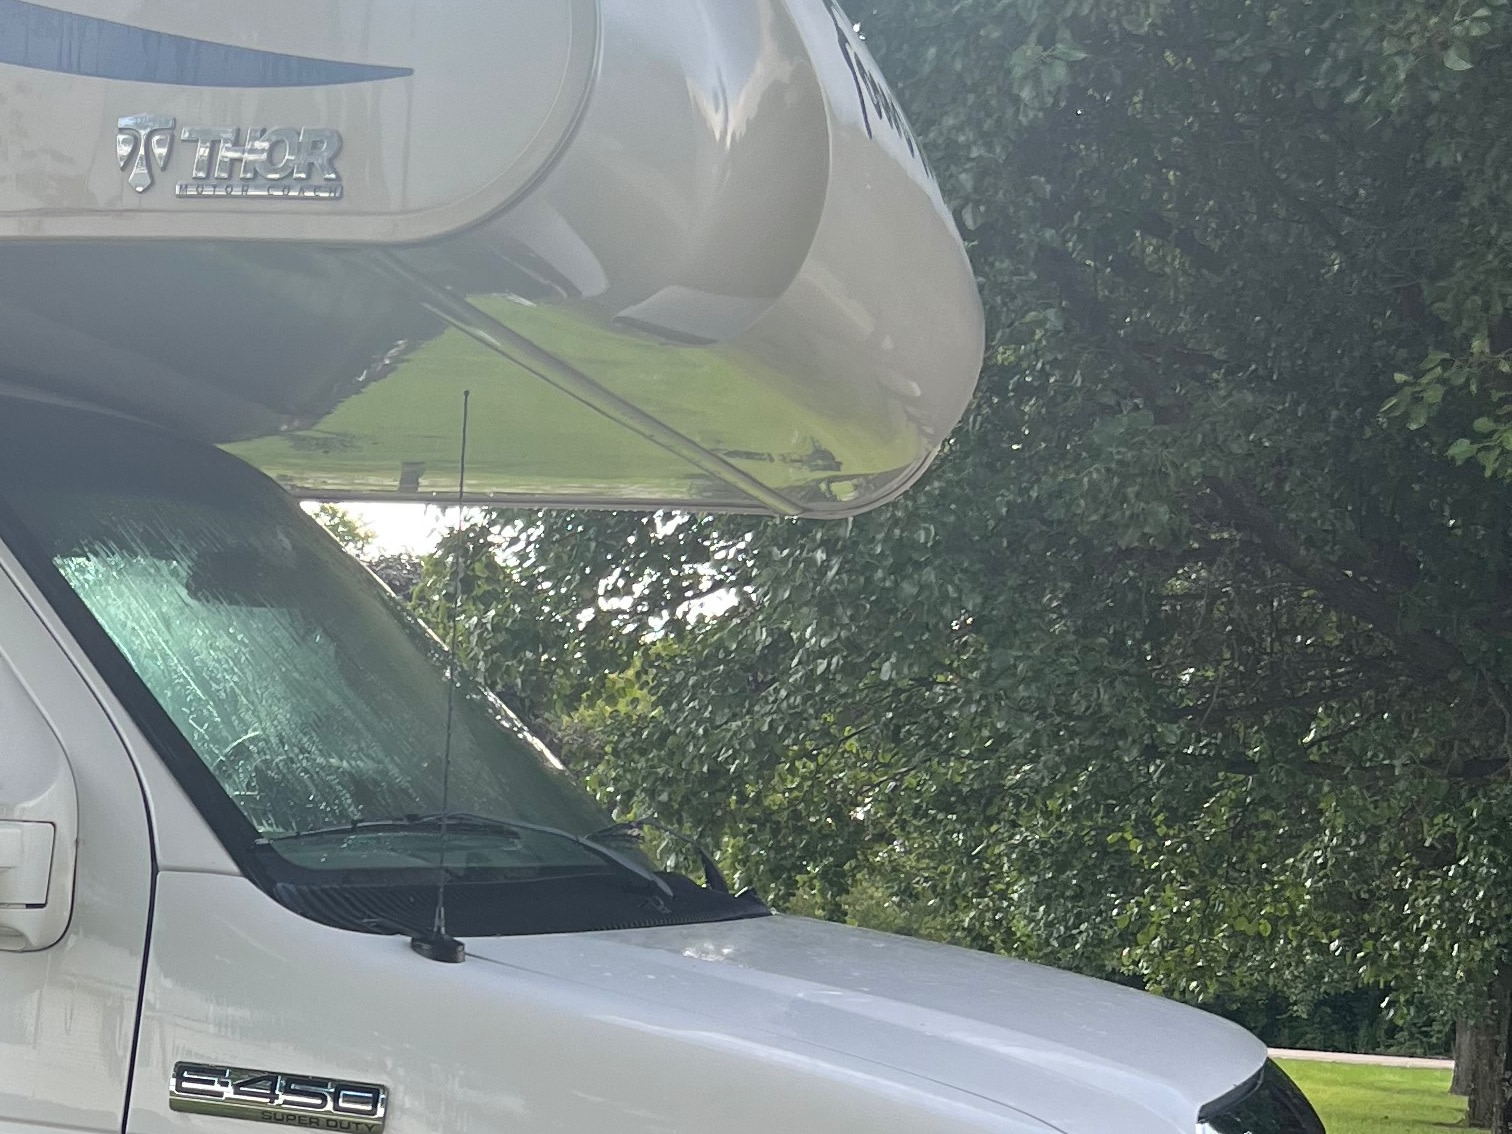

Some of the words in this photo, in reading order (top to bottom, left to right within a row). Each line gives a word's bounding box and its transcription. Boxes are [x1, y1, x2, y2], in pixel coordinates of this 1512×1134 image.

[181, 127, 343, 181] THOR
[178, 183, 250, 196] MOTOR
[267, 183, 337, 197] COACH
[261, 1110, 320, 1127] SUPER
[326, 1119, 377, 1133] DUTY
